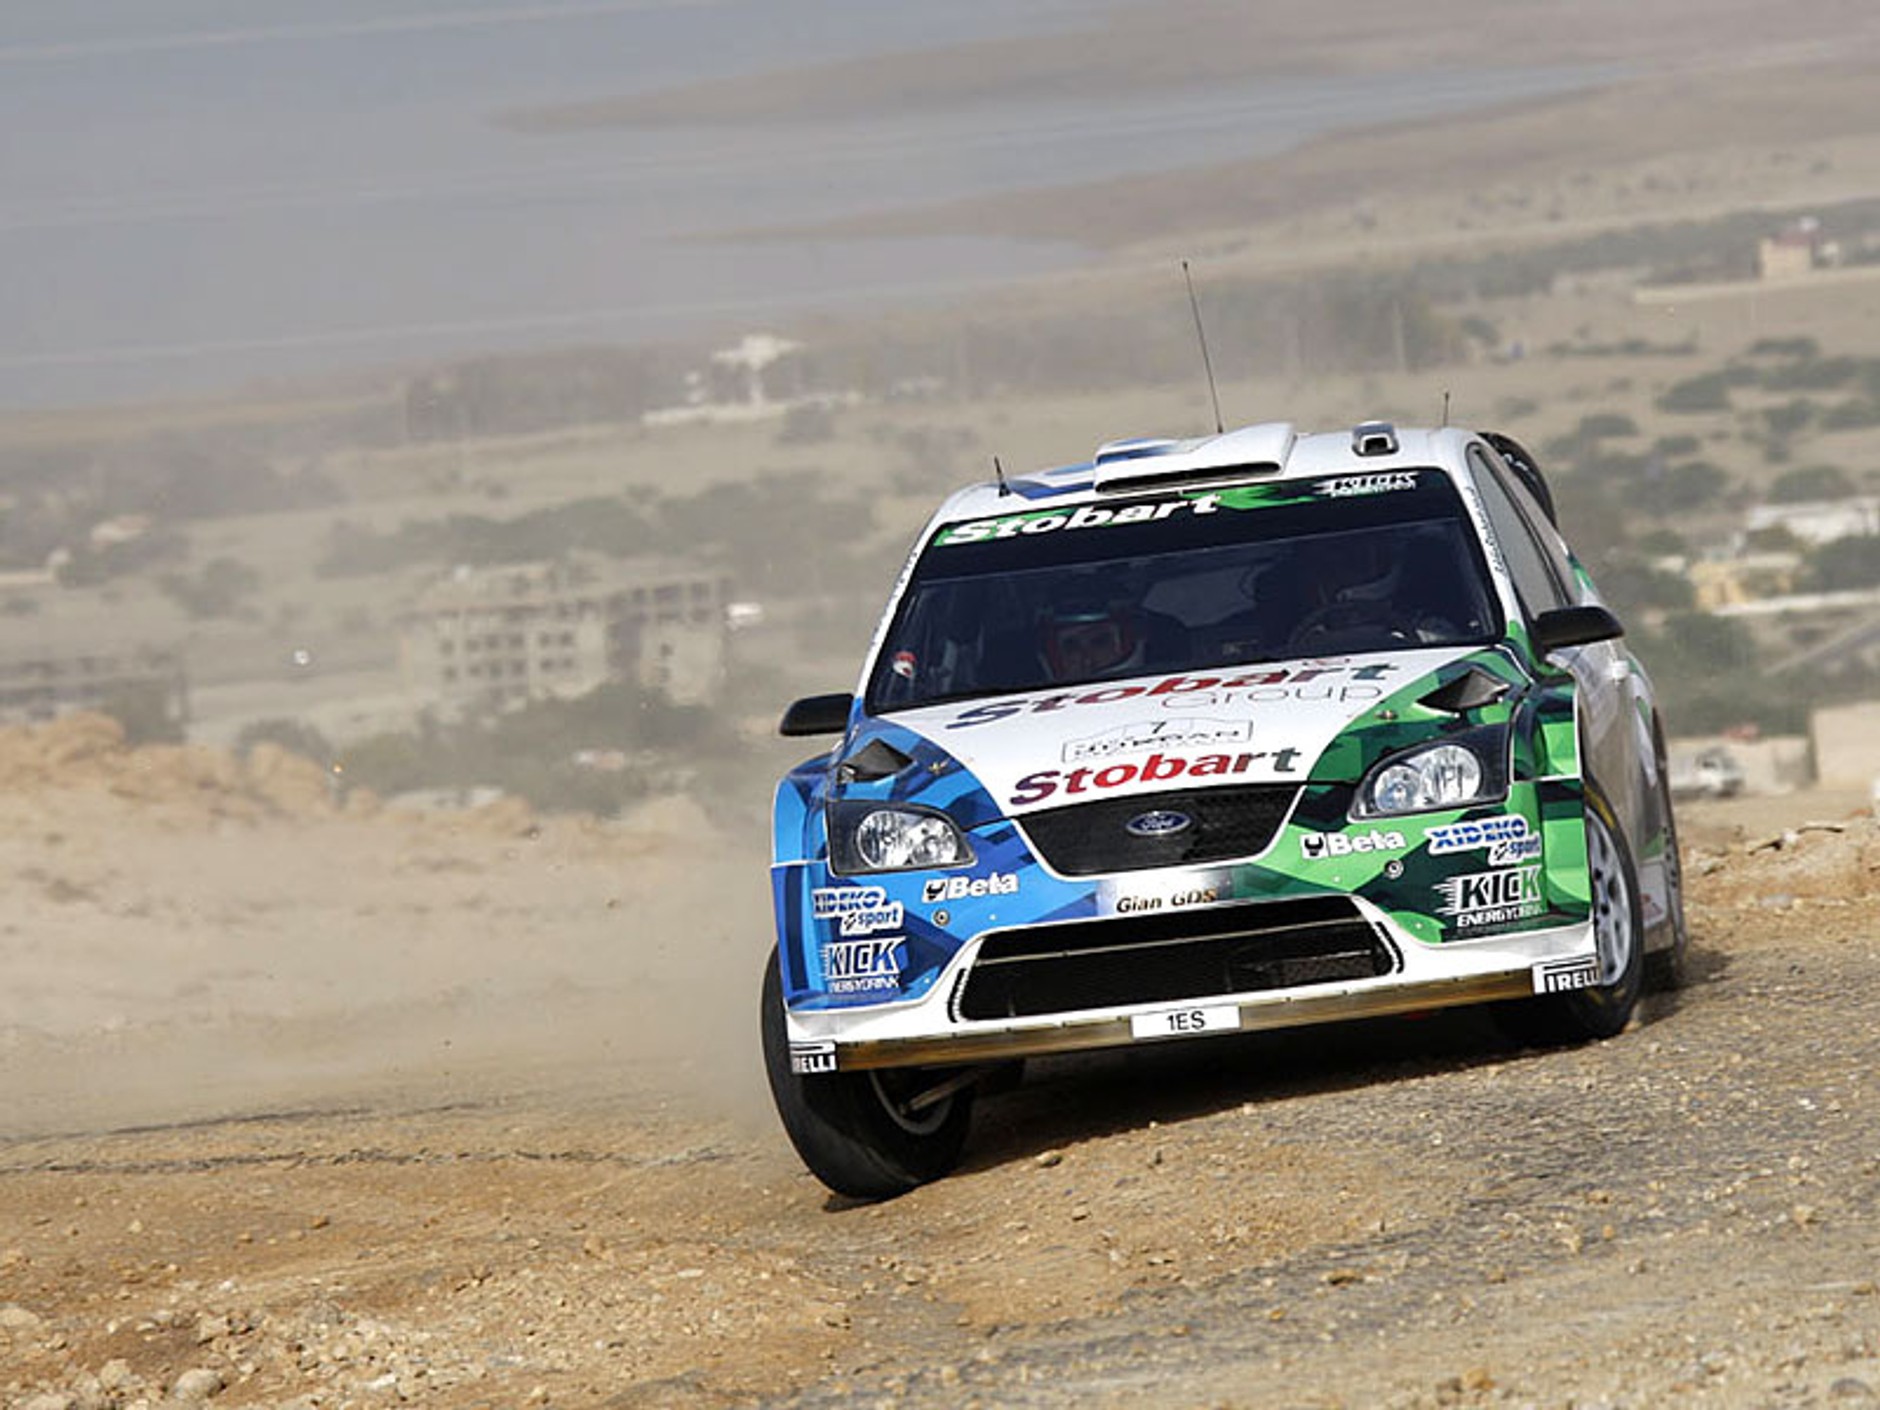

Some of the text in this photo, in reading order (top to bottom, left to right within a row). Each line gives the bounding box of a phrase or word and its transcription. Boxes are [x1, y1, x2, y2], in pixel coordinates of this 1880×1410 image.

[943, 494, 1221, 544] Stobart
[946, 663, 1399, 729] Stobart
[1150, 721, 1167, 735] 7
[1009, 747, 1302, 806] Stobart
[1328, 830, 1407, 856] Beta
[946, 872, 1019, 899] Beta
[1458, 867, 1541, 912] KICK
[857, 908, 899, 927] sport
[1116, 895, 1162, 913] Gian
[828, 940, 902, 976] KICK
[1167, 1010, 1206, 1031] 1ES
